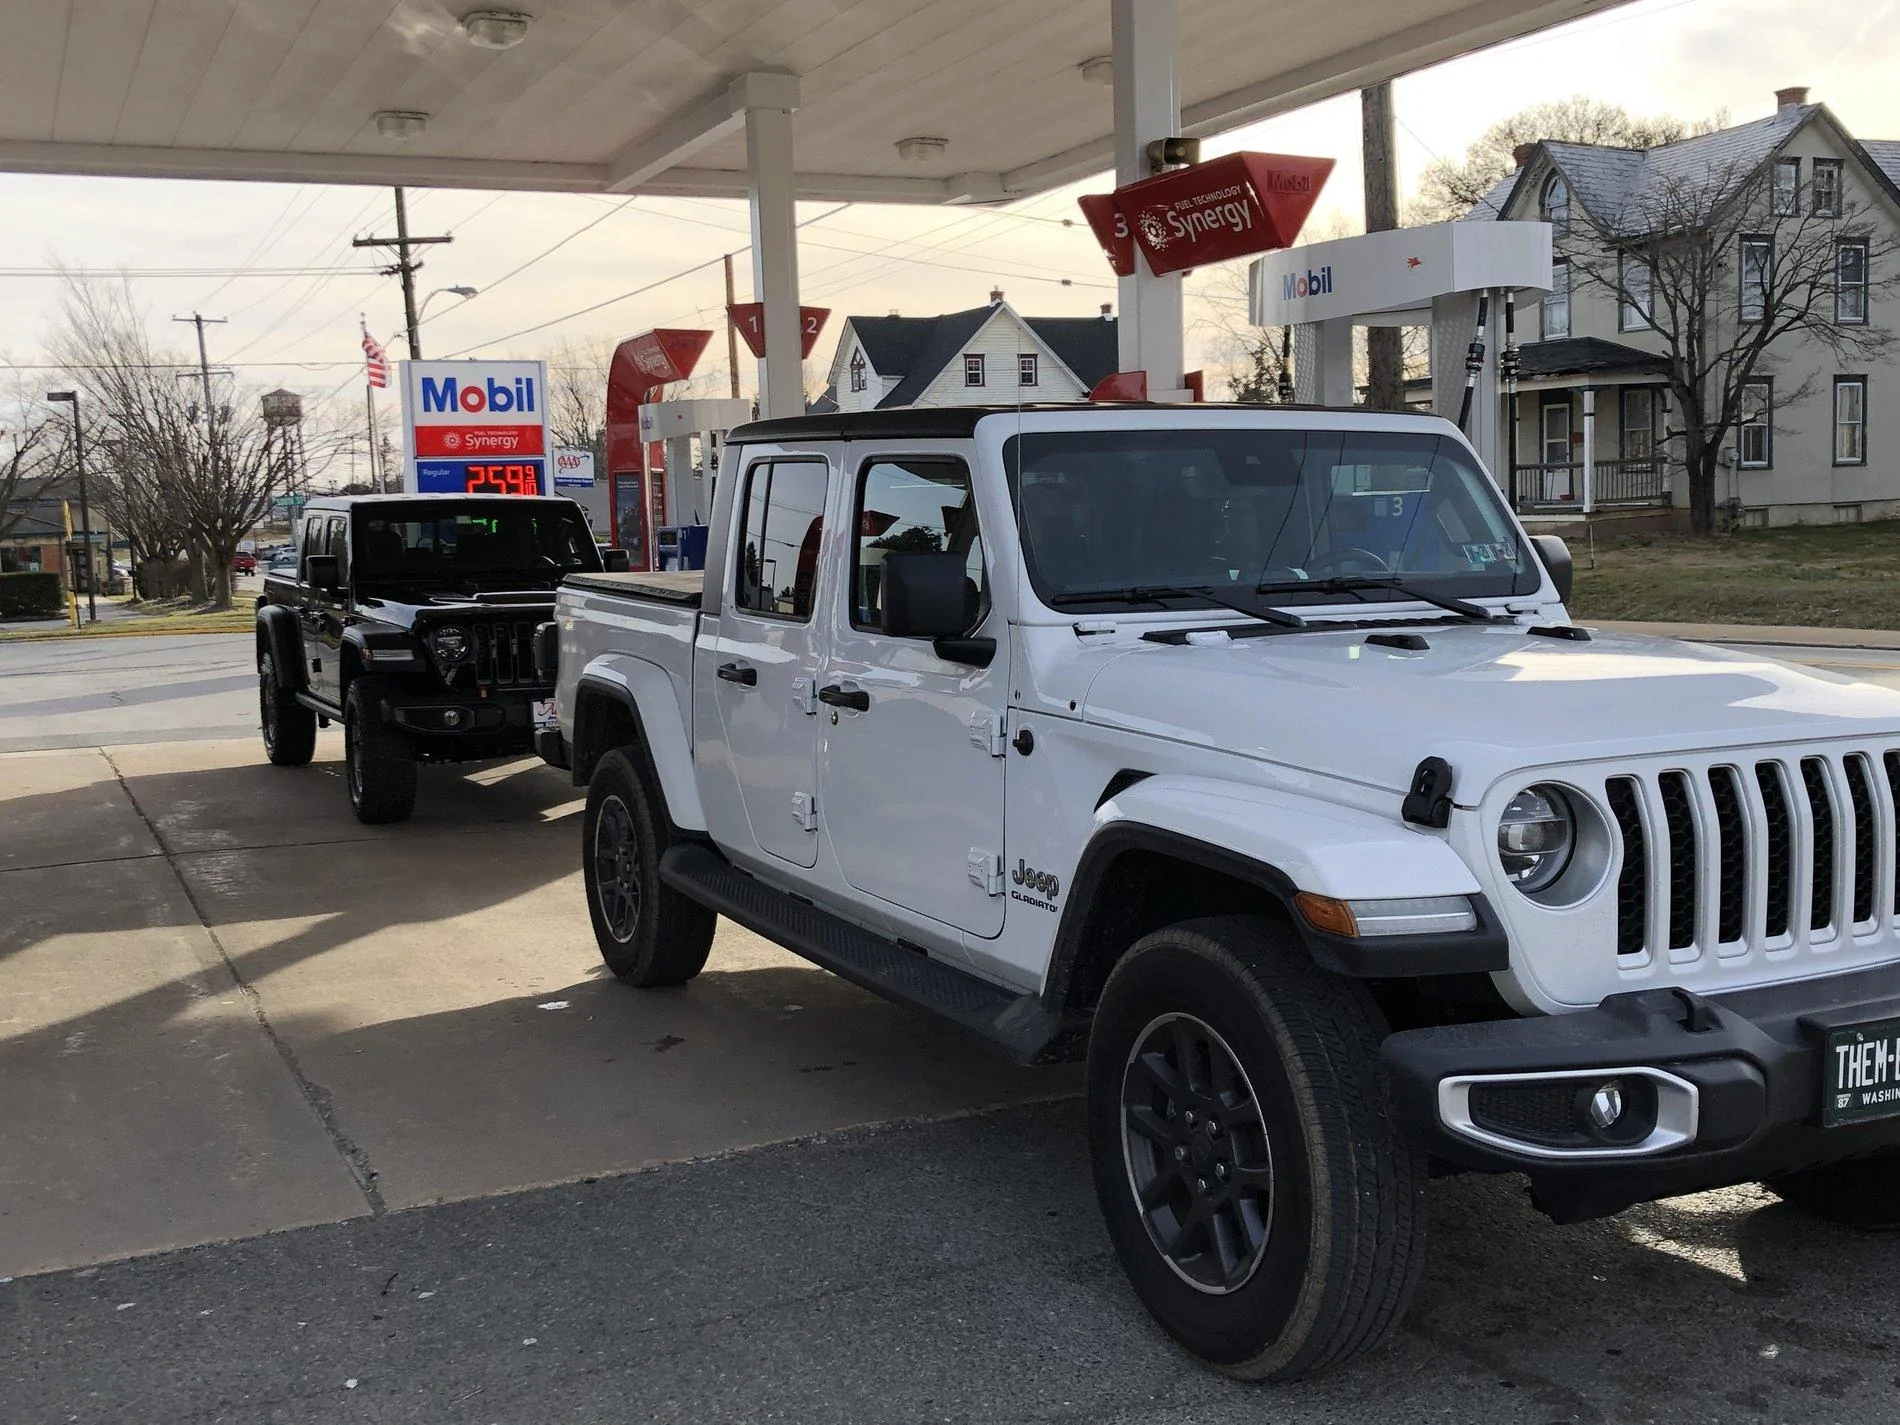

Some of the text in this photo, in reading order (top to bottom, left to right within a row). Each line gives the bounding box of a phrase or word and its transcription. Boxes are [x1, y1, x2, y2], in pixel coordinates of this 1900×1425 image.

[1175, 185, 1242, 211] FUEL TECHNOLOGY
[1114, 213, 1129, 238] 3
[1166, 199, 1252, 243] Synergy
[1283, 266, 1332, 301] Mobil
[749, 315, 758, 333] 1
[807, 316, 817, 334] 2
[422, 377, 535, 413] Mobil
[465, 433, 519, 449] Synergy
[560, 455, 579, 468] AAA
[423, 468, 450, 478] Regular
[1392, 496, 1403, 517] 3
[1012, 858, 1059, 900] Jeep
[1837, 1097, 1850, 1109] 87
